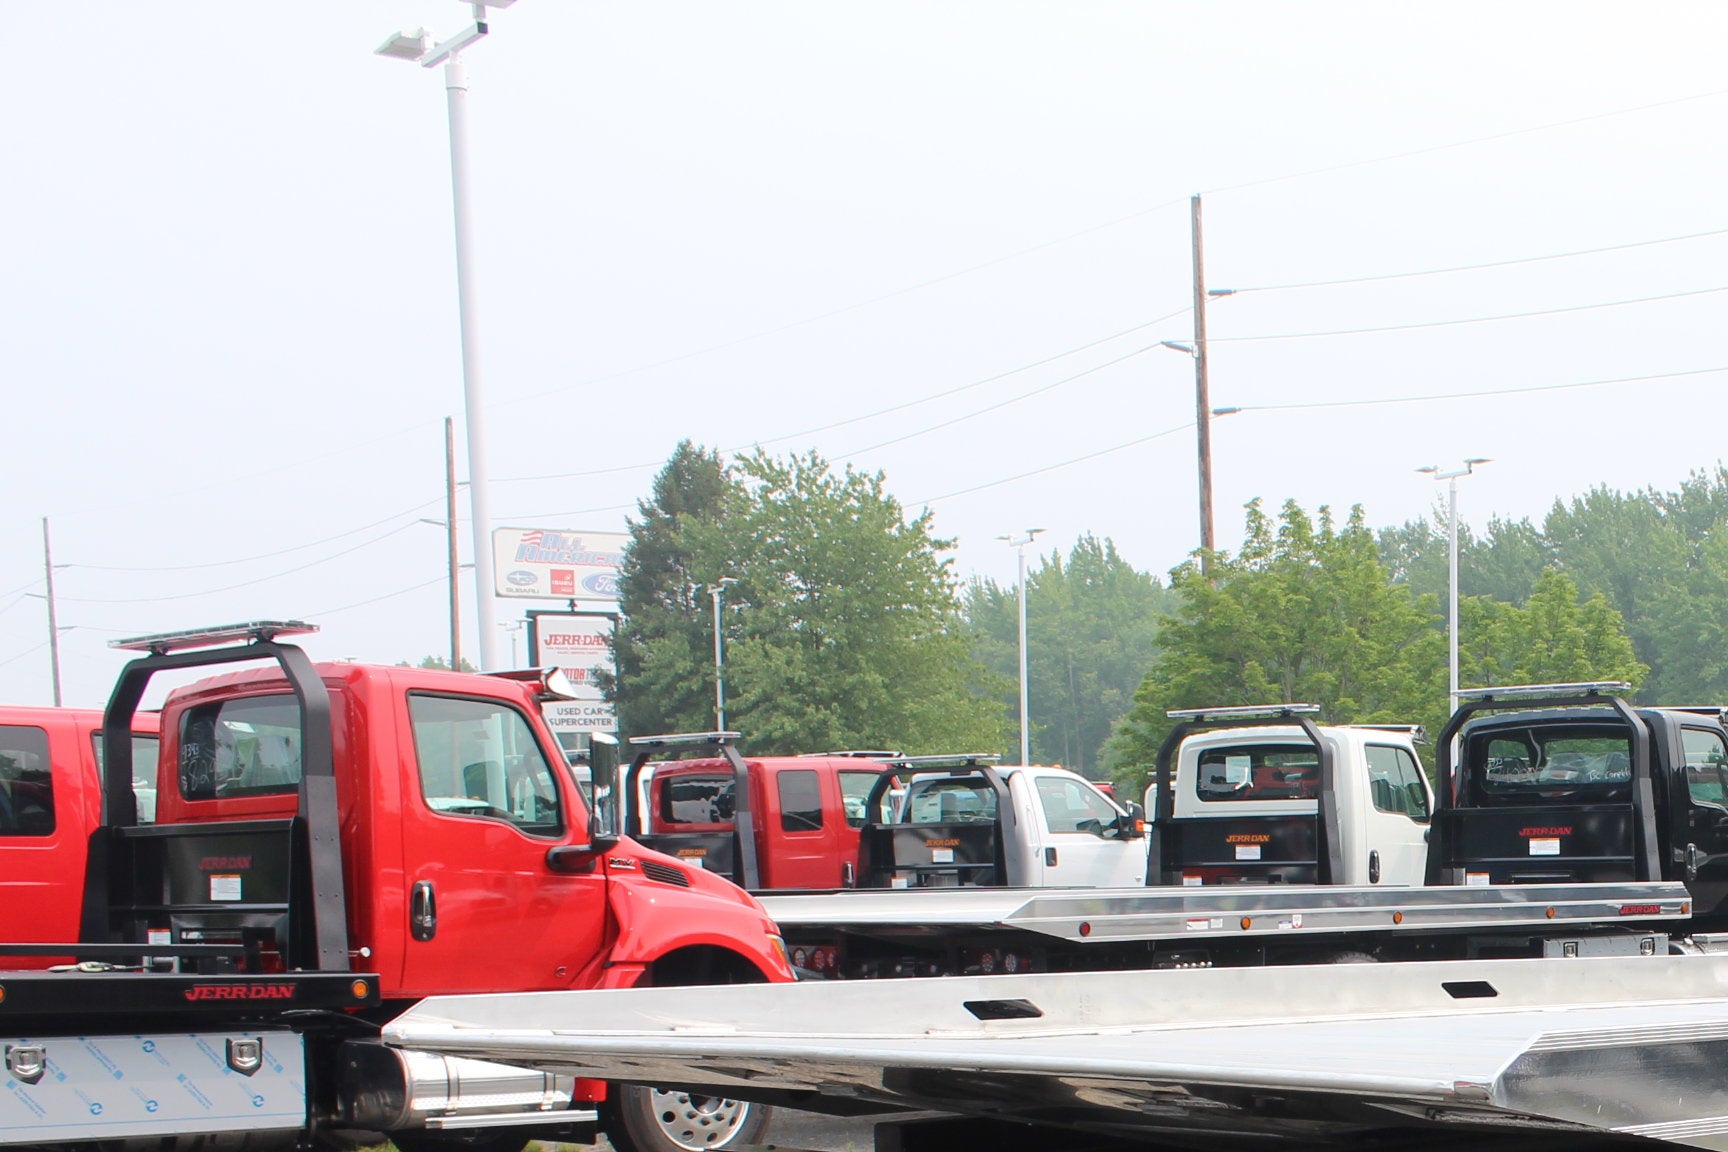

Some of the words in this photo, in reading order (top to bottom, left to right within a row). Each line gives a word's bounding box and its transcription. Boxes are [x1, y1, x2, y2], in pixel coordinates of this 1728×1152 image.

[515, 543, 627, 567] AMERICA
[557, 707, 581, 716] USED
[549, 717, 613, 726] SUPERCENTER
